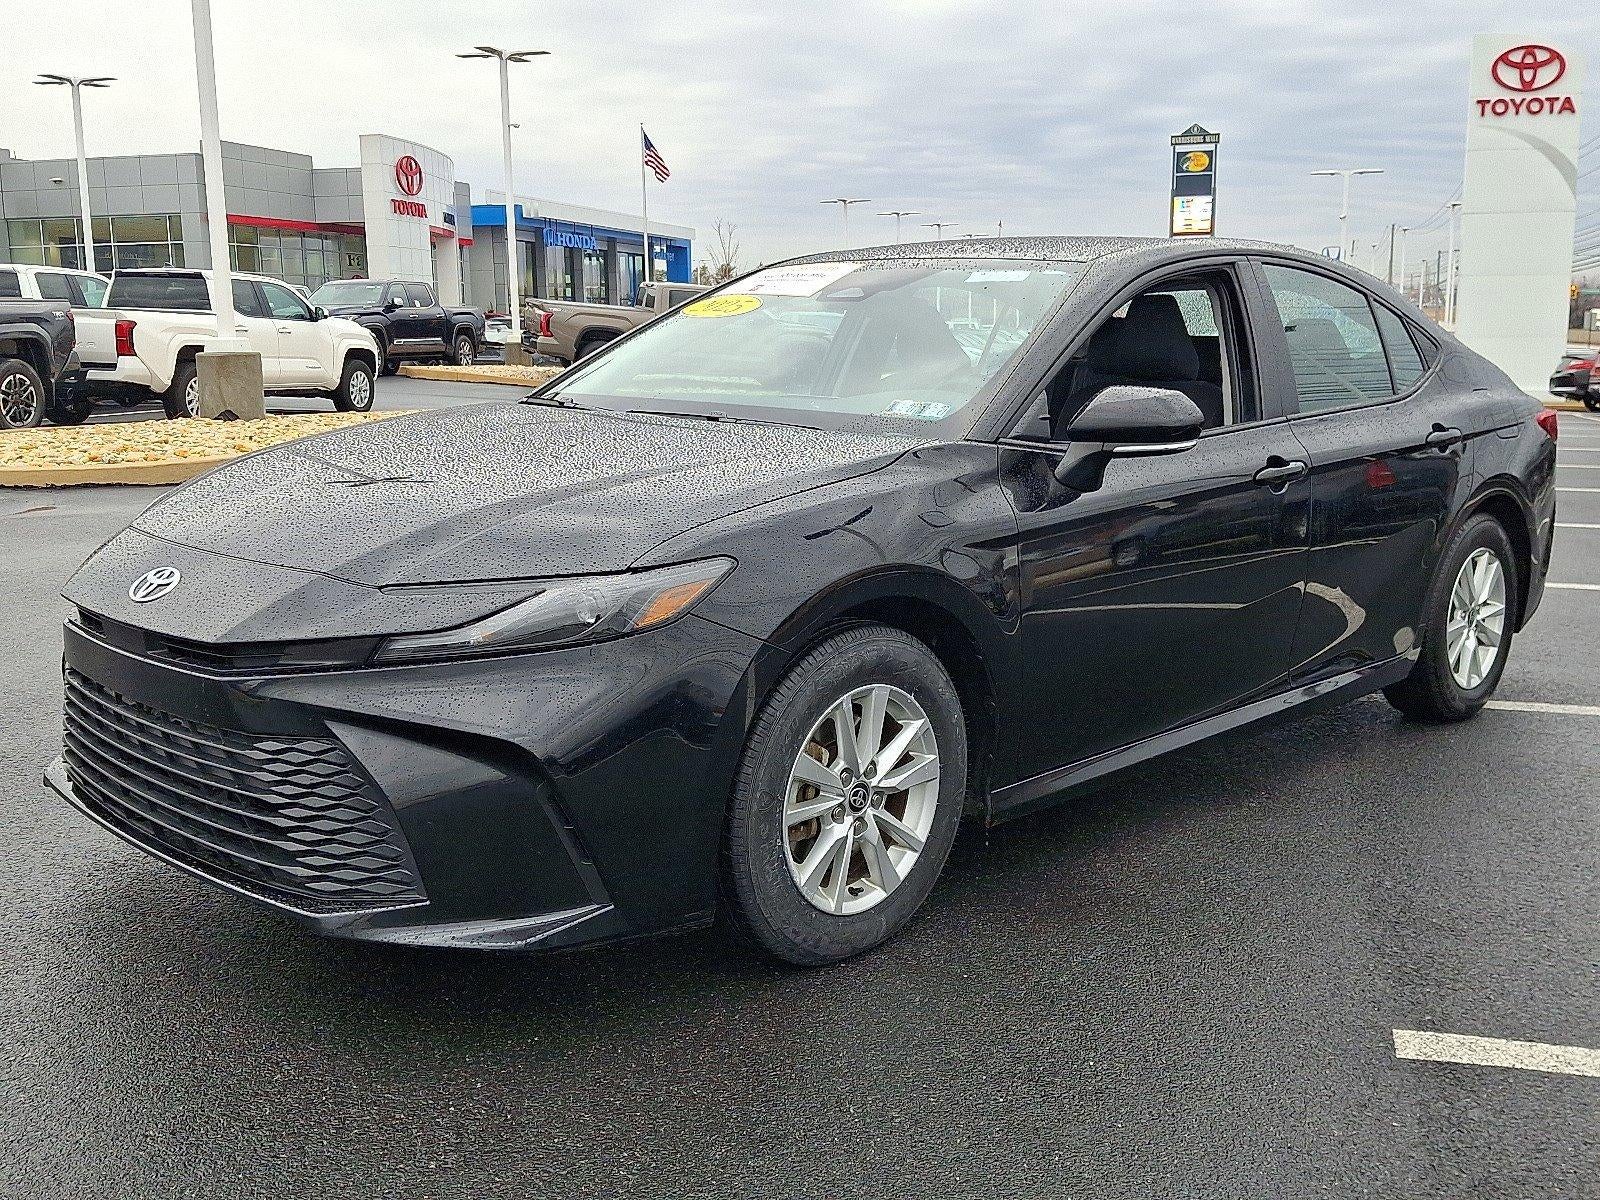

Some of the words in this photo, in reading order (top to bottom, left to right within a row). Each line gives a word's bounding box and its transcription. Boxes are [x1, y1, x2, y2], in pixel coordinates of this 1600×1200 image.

[1476, 96, 1576, 117] TOYOTA
[390, 198, 428, 219] TOYOTA
[556, 231, 598, 250] HONDA
